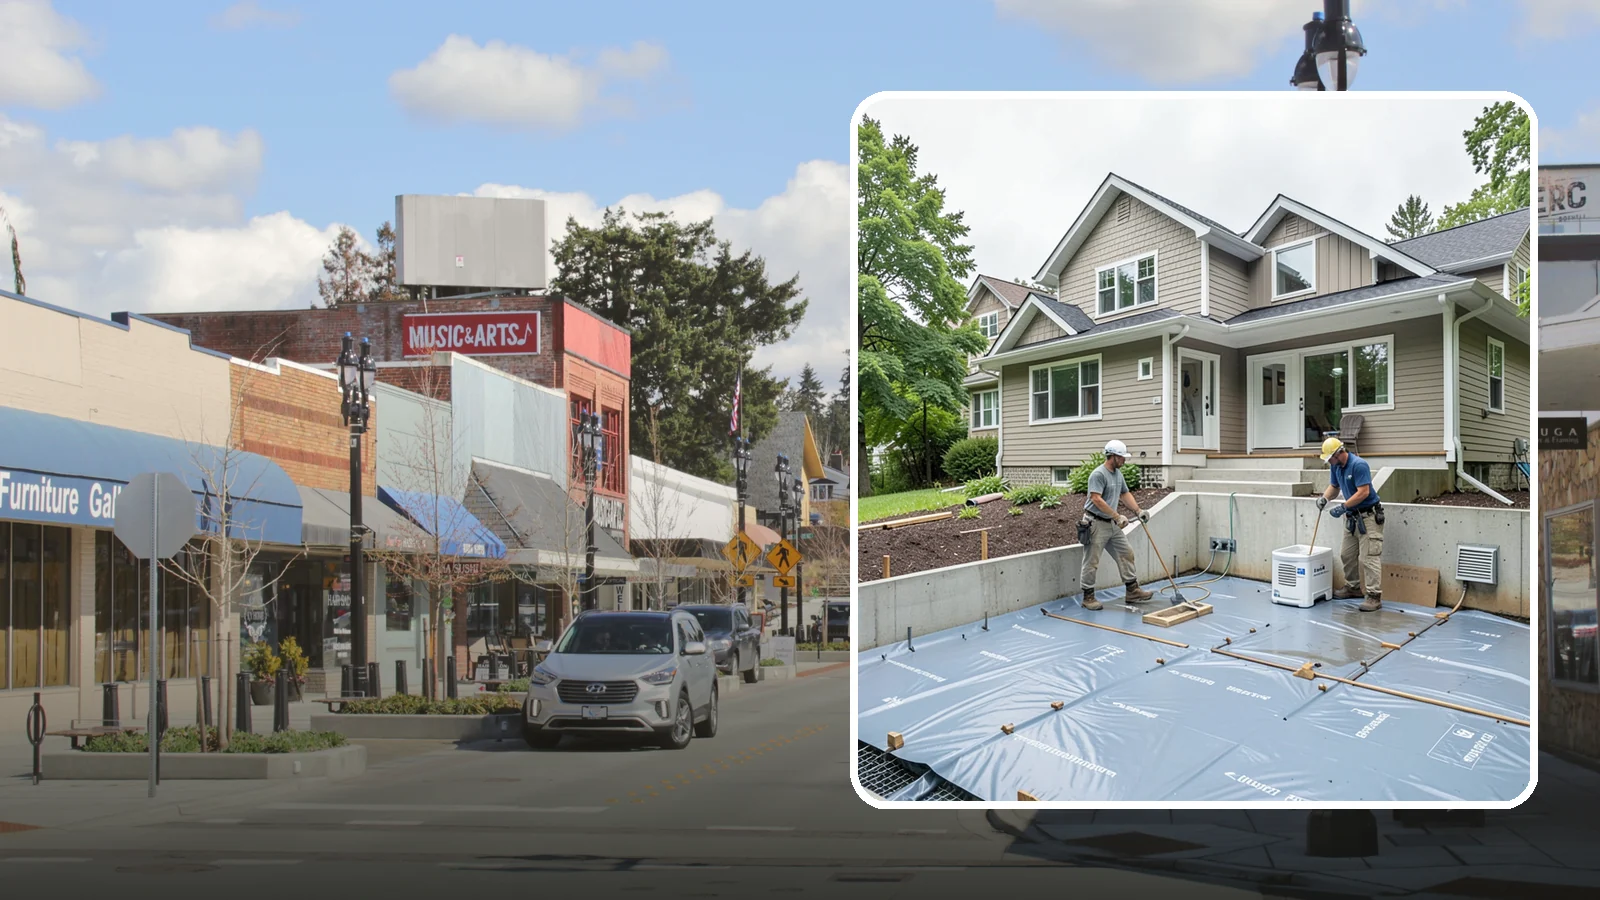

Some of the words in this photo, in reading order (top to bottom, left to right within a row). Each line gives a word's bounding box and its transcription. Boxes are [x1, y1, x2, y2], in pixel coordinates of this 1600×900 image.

[409, 323, 520, 348] MUSIC&ARTS
[1540, 428, 1577, 436] UGA
[0, 471, 79, 515] Furniture
